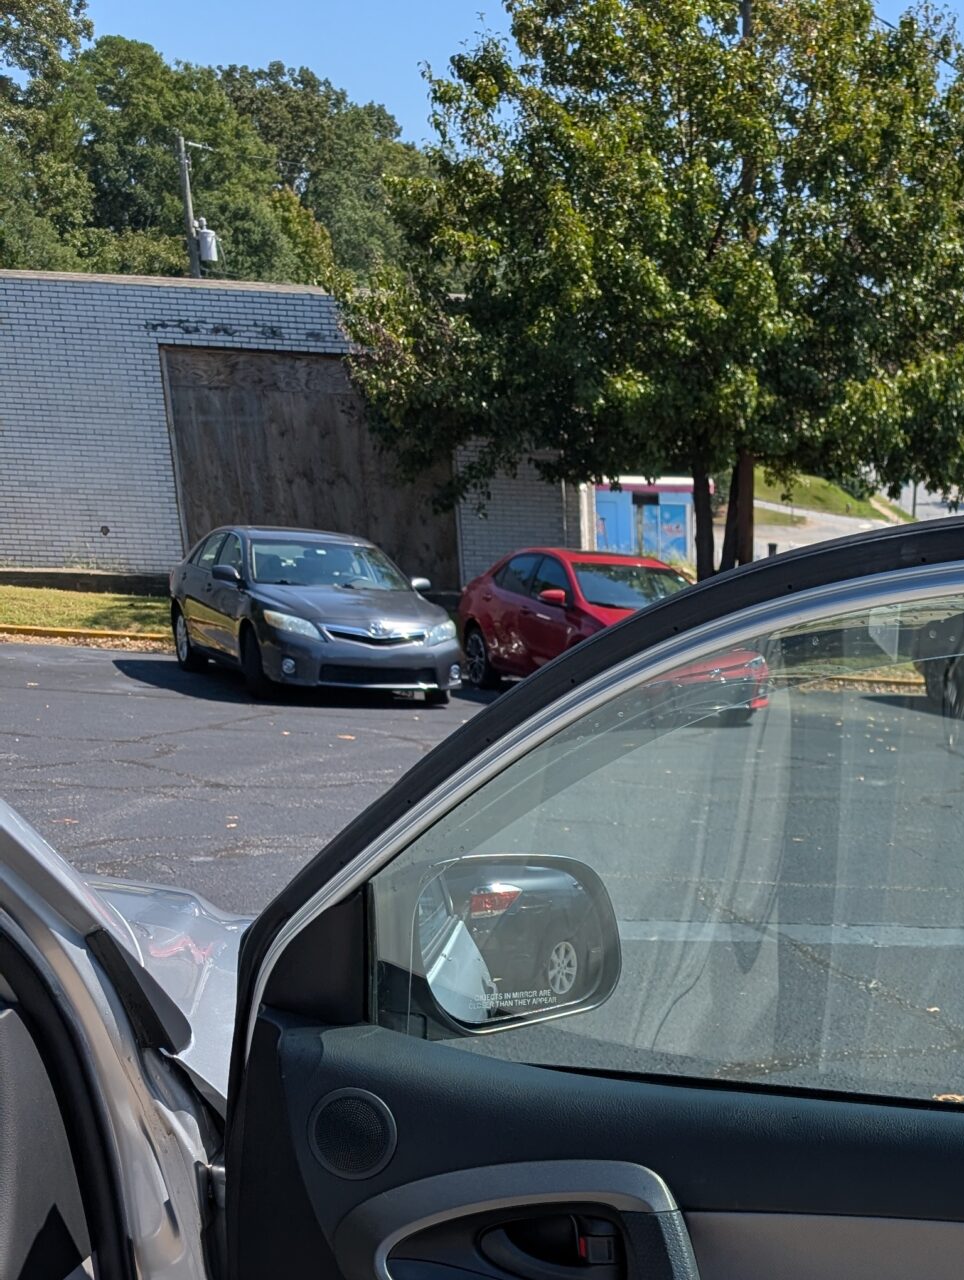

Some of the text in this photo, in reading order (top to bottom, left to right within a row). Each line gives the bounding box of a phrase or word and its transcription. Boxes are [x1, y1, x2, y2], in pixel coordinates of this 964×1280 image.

[474, 993, 503, 1001] OBJECTS
[512, 990, 537, 998] MIRROR
[539, 989, 551, 997] ARE
[468, 1000, 495, 1010] CLOSER
[515, 998, 530, 1006] THEY
[532, 996, 557, 1005] APPEAR
